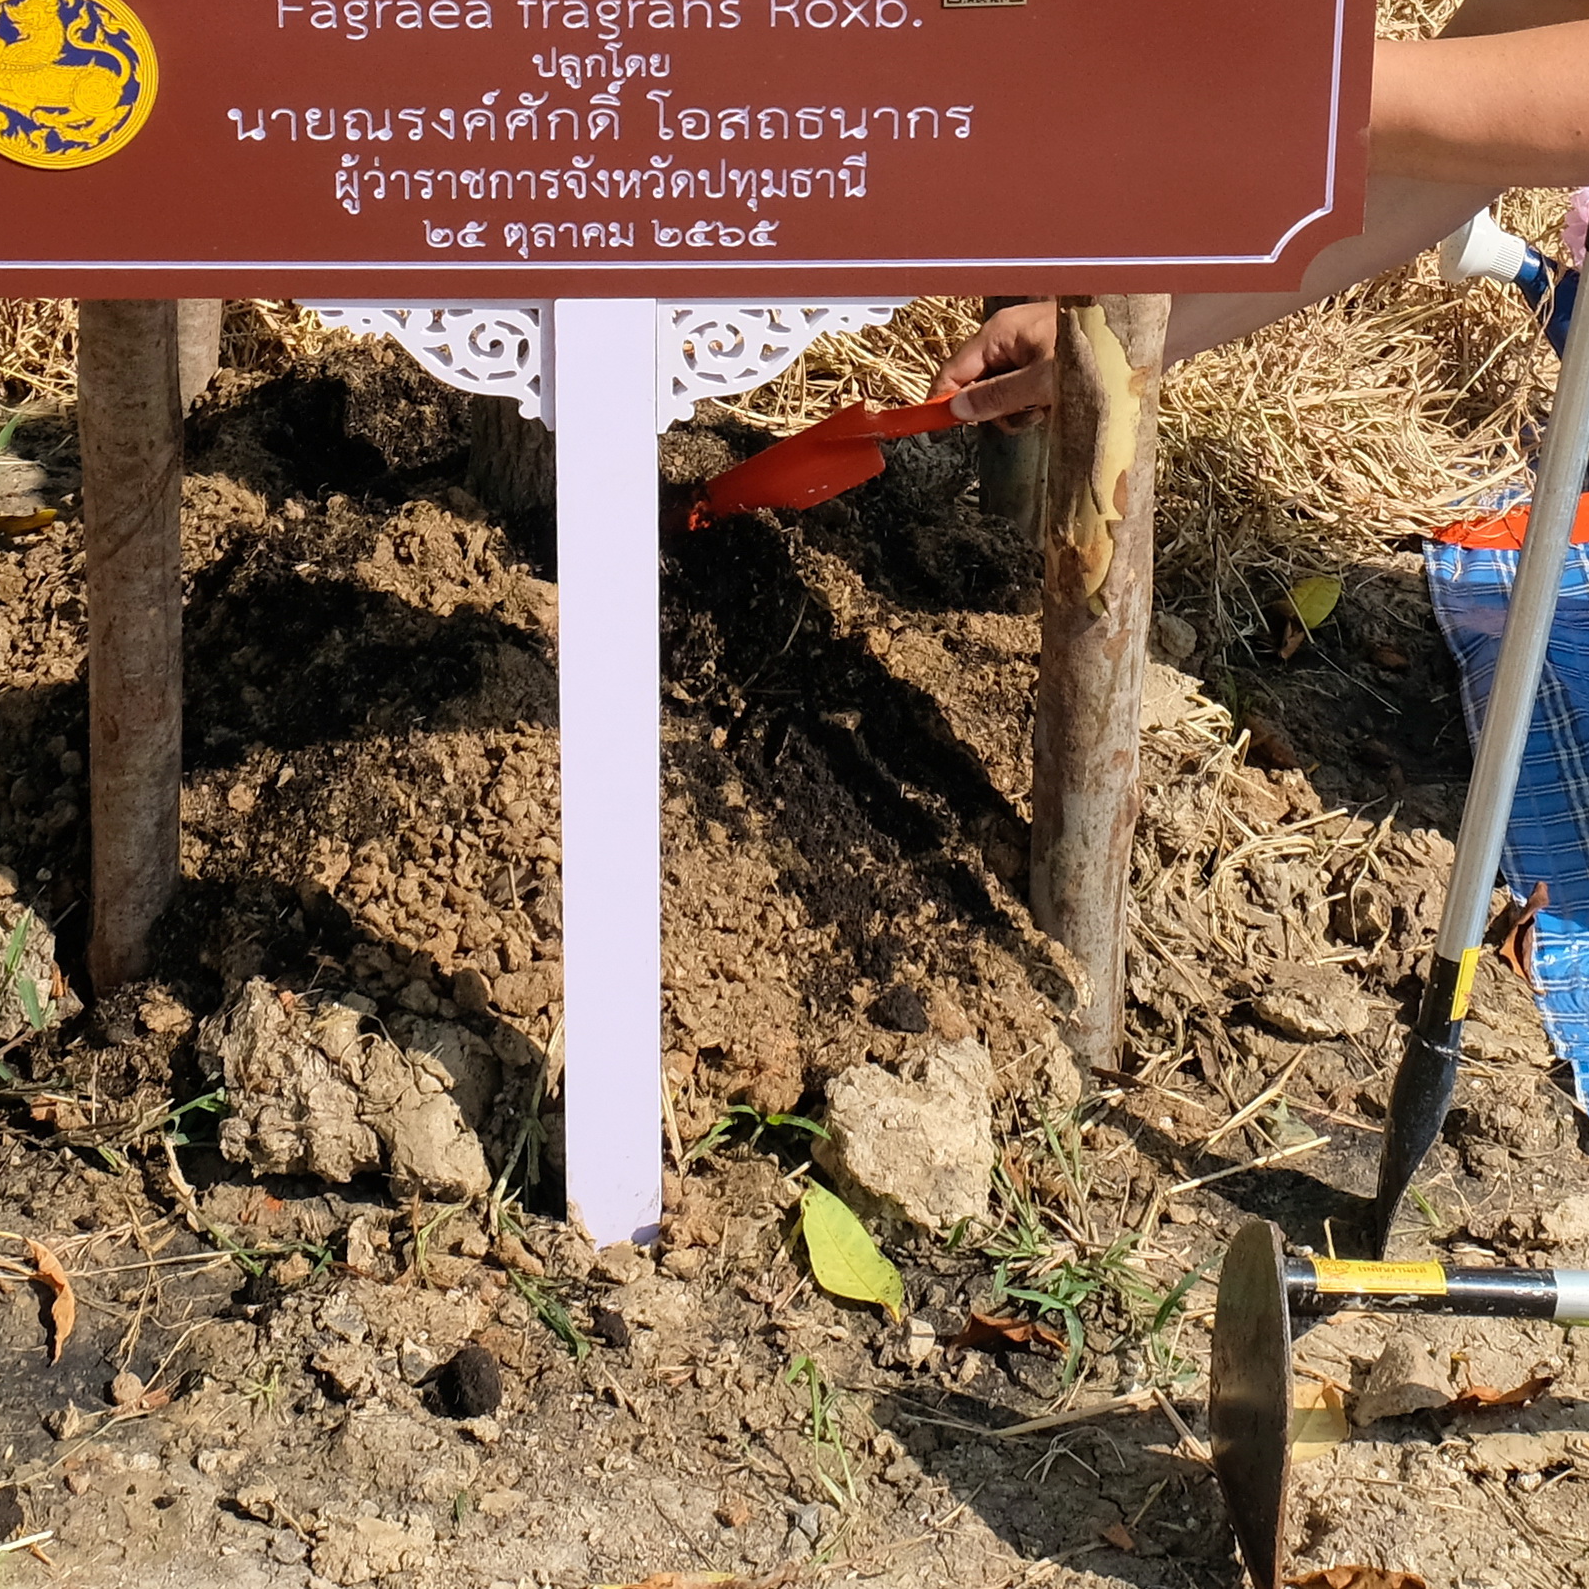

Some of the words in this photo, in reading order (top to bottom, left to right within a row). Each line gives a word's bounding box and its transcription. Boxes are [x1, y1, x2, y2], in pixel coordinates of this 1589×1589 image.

[531, 41, 671, 90] ปลูกโดย
[226, 77, 627, 143] นายณรงค์ศักดิ์
[645, 88, 975, 141] โอสถธนากร
[334, 150, 868, 215] ผู้ว่าราชการจังหวัดปทุมธานี
[422, 219, 488, 249] ๒๕
[503, 221, 635, 260] ตุลาคม
[650, 218, 780, 248] ๒๕๖๕
